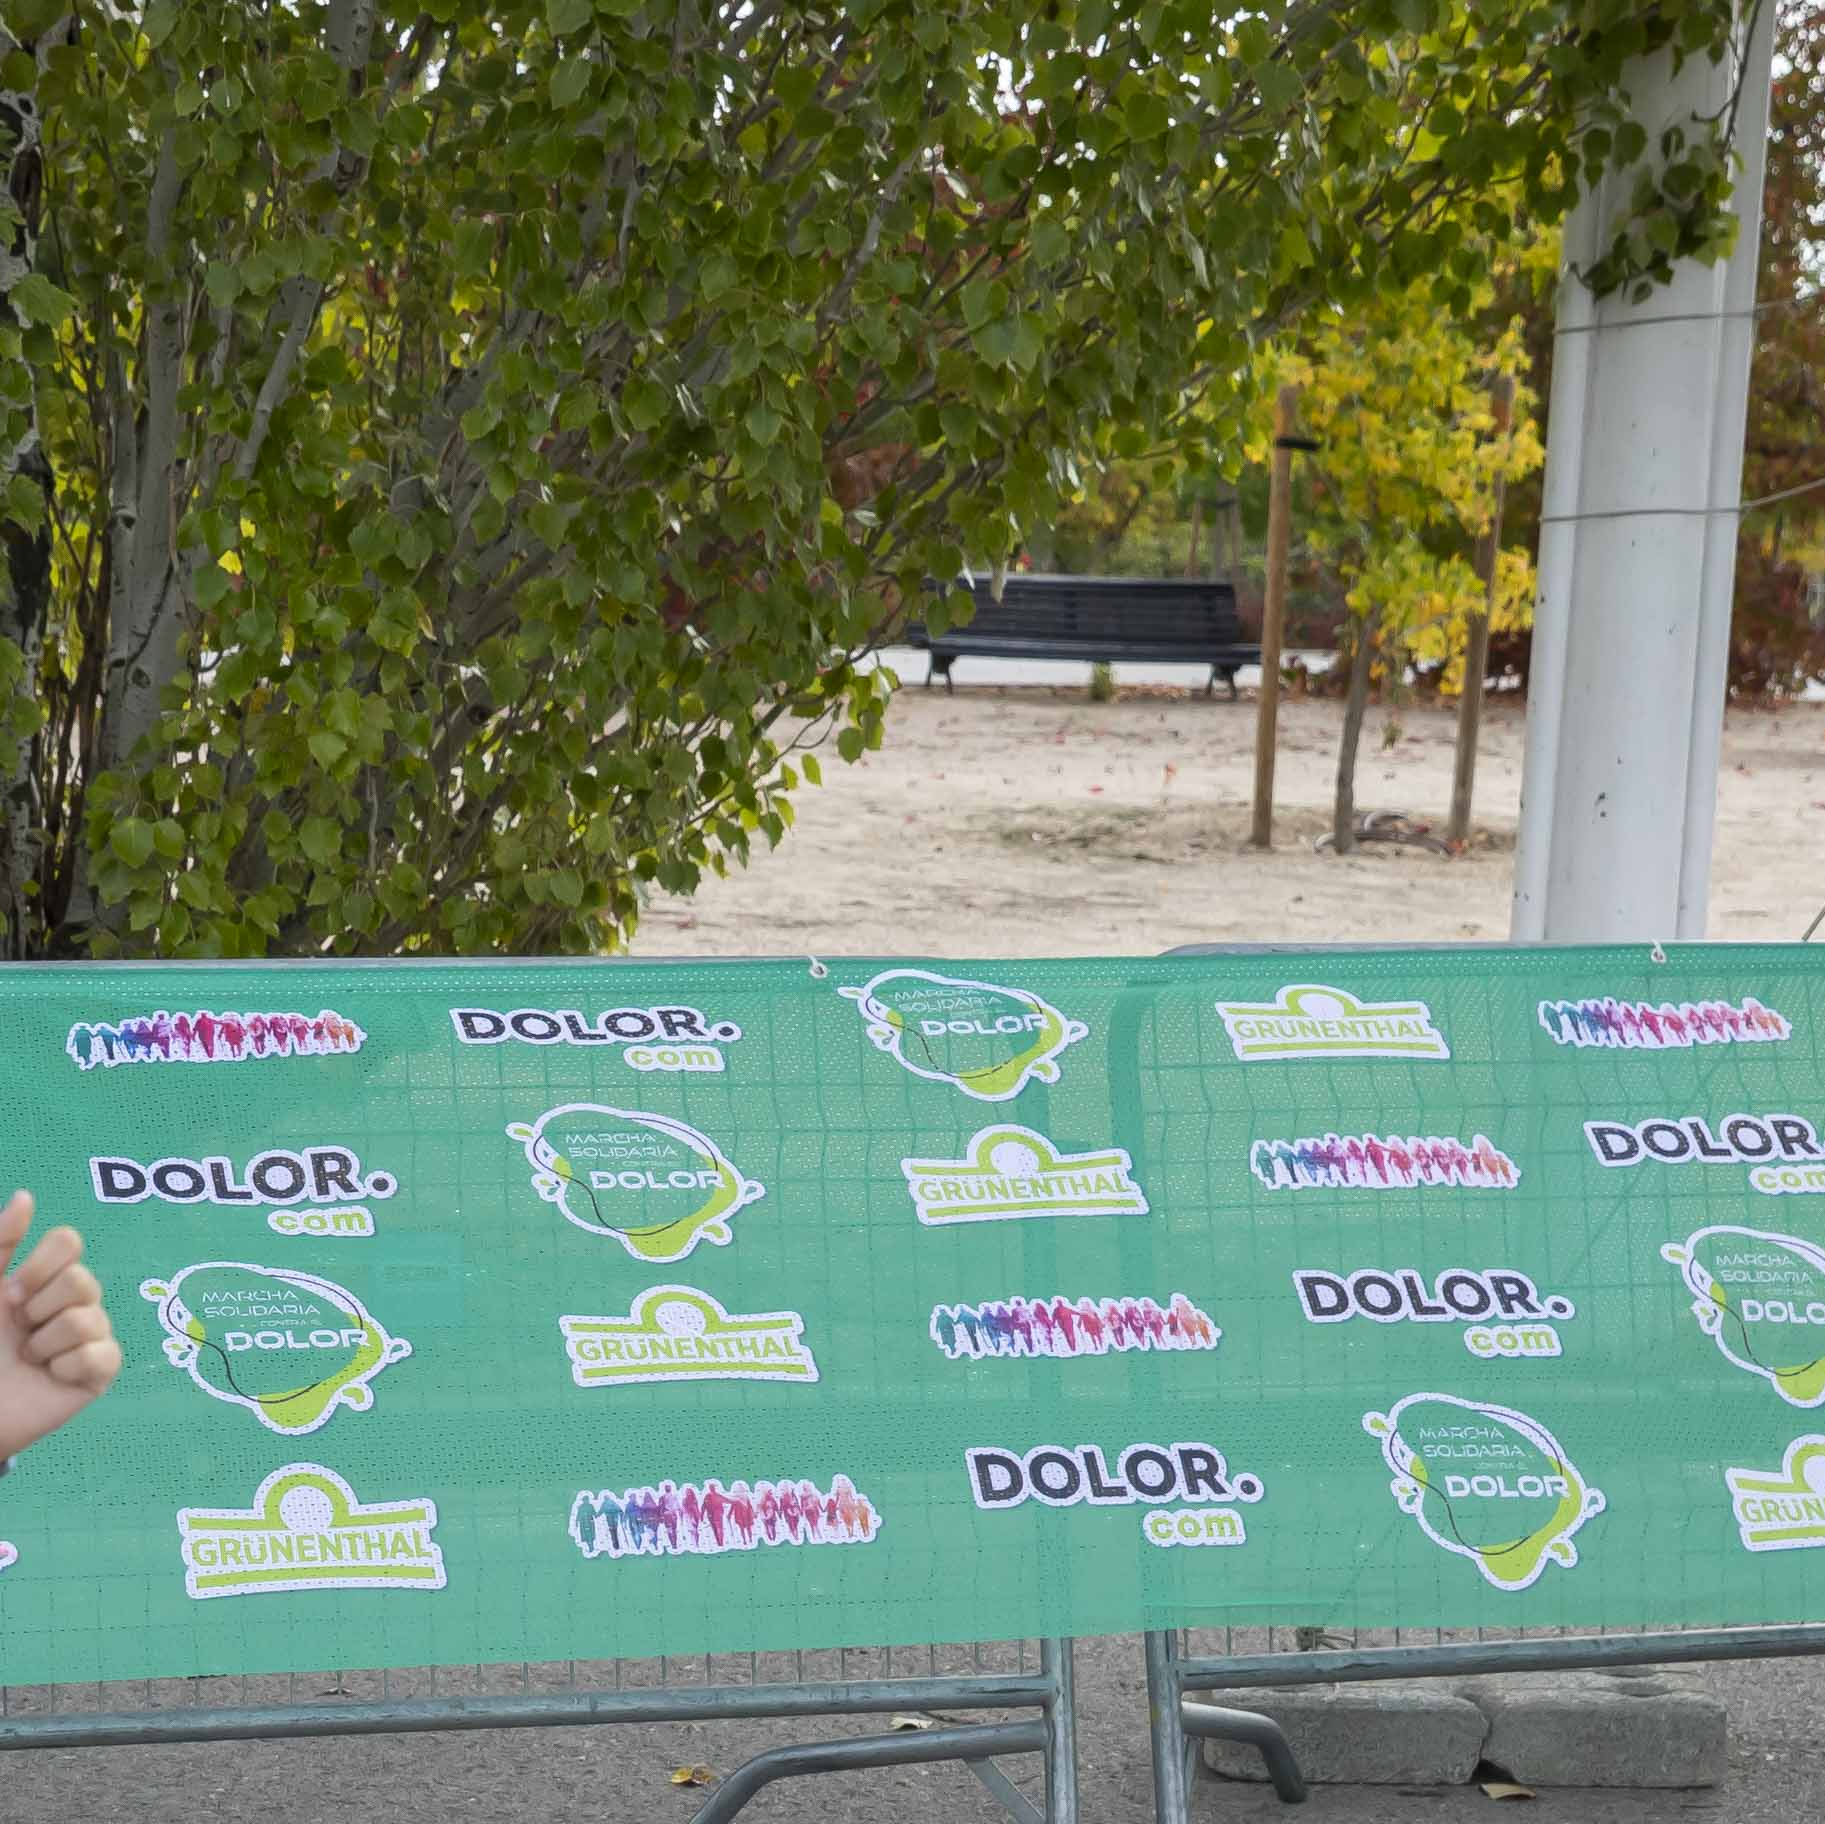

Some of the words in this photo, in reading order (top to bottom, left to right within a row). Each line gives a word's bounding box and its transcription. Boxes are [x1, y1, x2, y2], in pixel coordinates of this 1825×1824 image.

[458, 1009, 735, 1040] DOLOR.
[921, 1013, 1050, 1036] DOLOR
[1233, 1016, 1433, 1041] GRÜNENTHAL
[631, 1047, 718, 1067] com
[565, 1133, 656, 1144] MARCHA
[568, 1145, 679, 1159] SOLIDARIA
[98, 1152, 389, 1200] DOLOR.
[589, 1170, 727, 1189] DOLOR
[918, 1173, 1130, 1201] GRÜNENTHAL
[275, 1208, 367, 1233] com
[1715, 1254, 1793, 1265] MARCHA
[202, 1290, 297, 1303] MARCHA
[1302, 1275, 1567, 1317] DOLOR.
[204, 1304, 321, 1318] SOLIDARIA
[224, 1328, 372, 1351] DOLOR
[576, 1333, 803, 1362] GRÜNENTHAL
[1471, 1330, 1555, 1351] com
[1419, 1426, 1505, 1440] MARCHA
[1423, 1444, 1526, 1457] SOLIDARIA
[976, 1449, 1257, 1502] DOLOR.
[1444, 1475, 1572, 1498] DOLOR
[1151, 1514, 1238, 1539] com
[191, 1530, 433, 1567] GRÜNENTHAL
